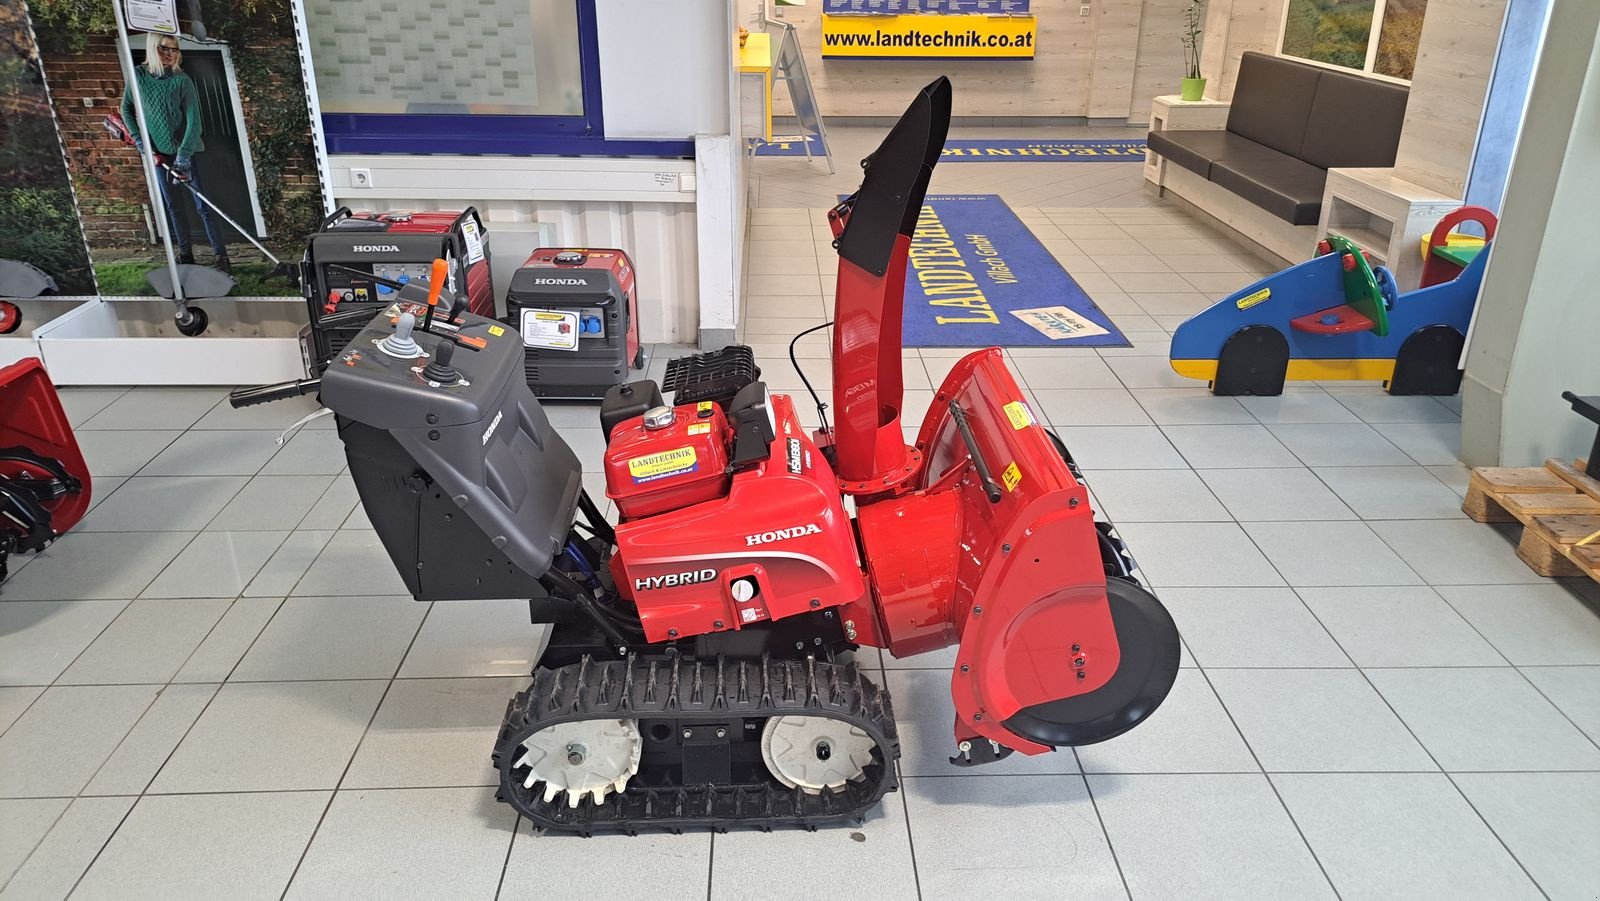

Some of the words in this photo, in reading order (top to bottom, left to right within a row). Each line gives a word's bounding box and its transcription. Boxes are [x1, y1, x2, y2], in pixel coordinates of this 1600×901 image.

[824, 30, 1032, 47] www.landtechnik.co.at
[964, 234, 999, 257] GmbH
[534, 278, 588, 286] HONDA
[979, 257, 1018, 284] Villach
[482, 411, 503, 446] HONDA
[631, 449, 692, 468] LANDTECHNIK
[745, 523, 822, 546] HONDA
[635, 568, 718, 591] HYBRID
